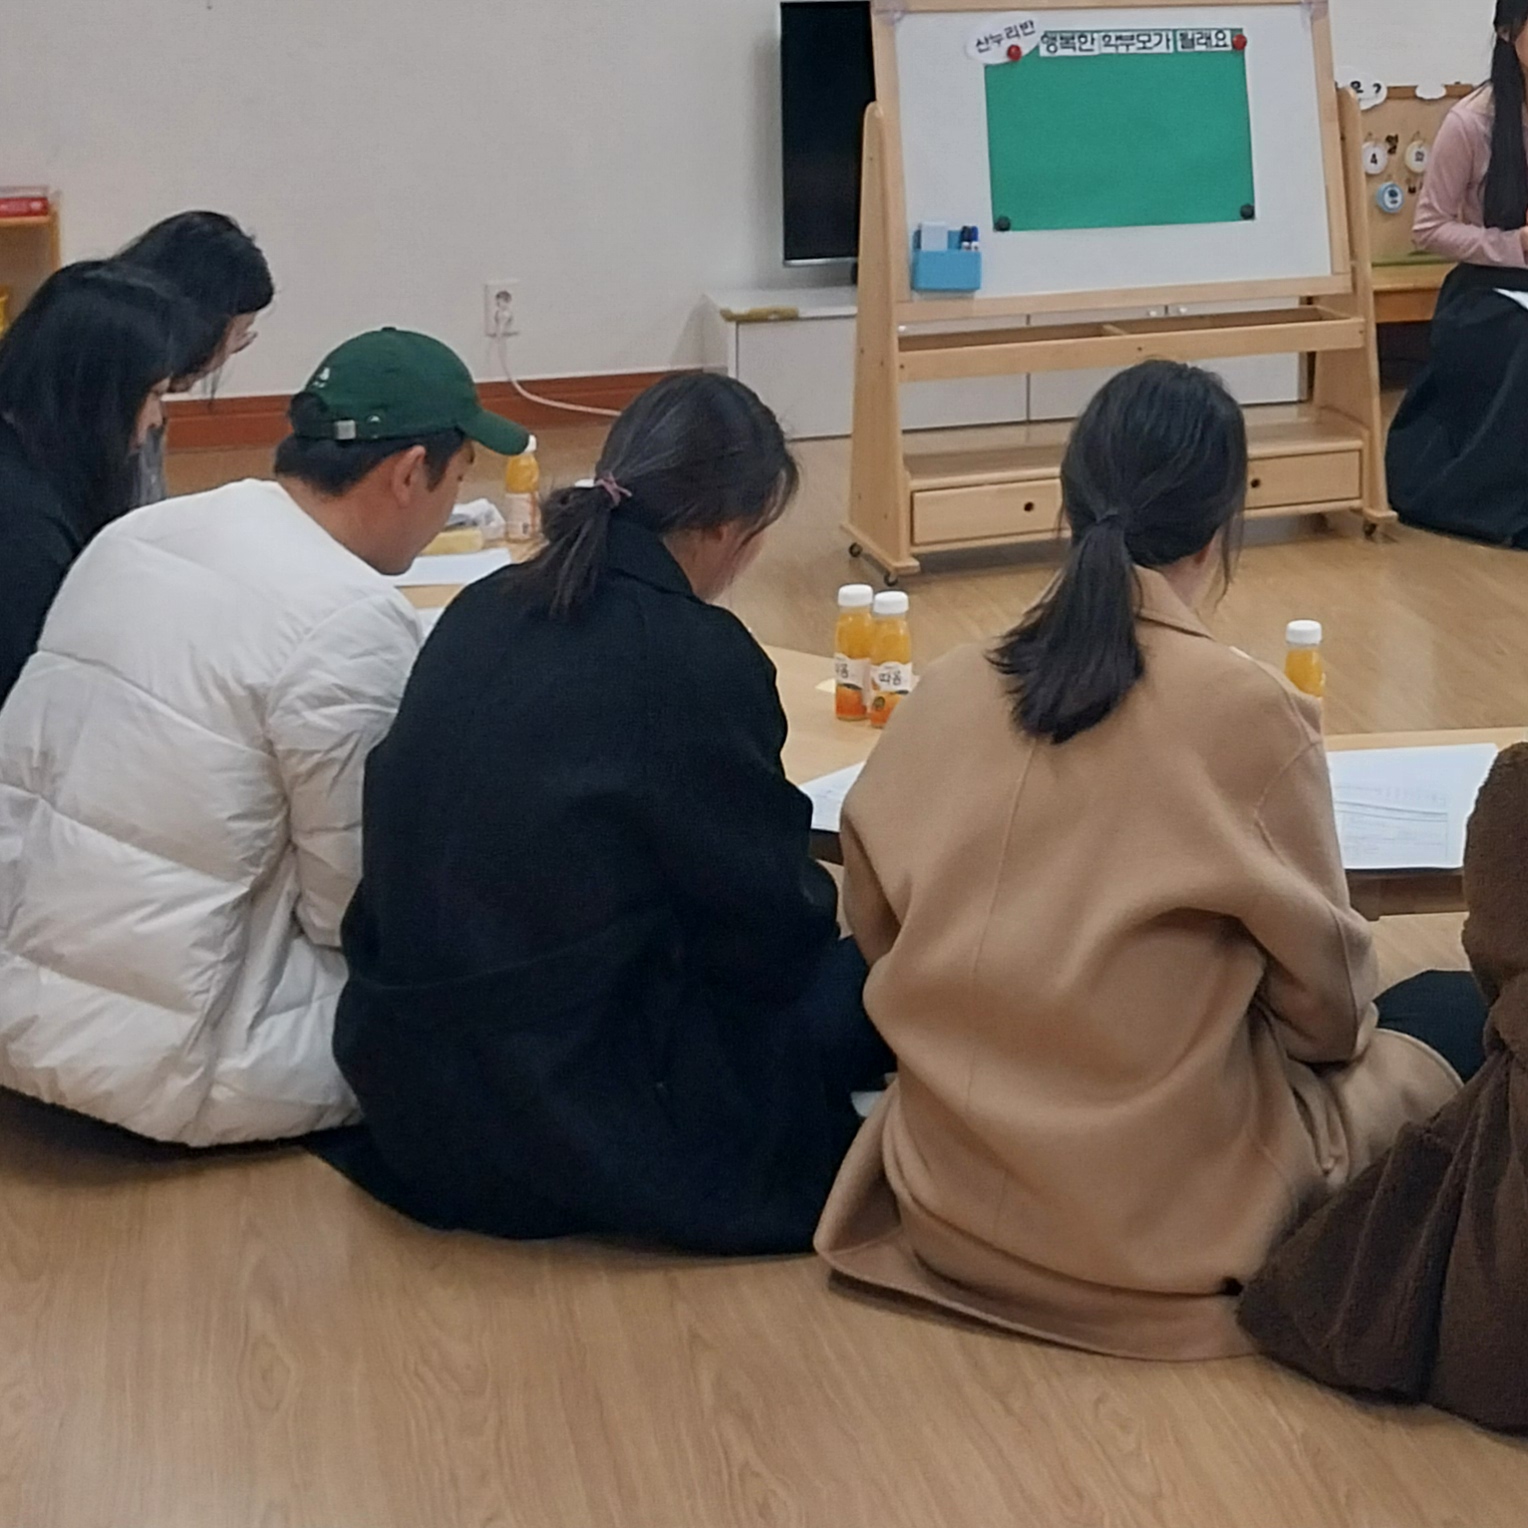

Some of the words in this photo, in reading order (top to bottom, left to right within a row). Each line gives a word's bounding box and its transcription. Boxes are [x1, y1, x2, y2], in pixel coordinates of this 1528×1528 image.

[1041, 32, 1096, 53] 행복한
[1101, 32, 1171, 53] 학부모가
[1180, 30, 1230, 50] 될래요
